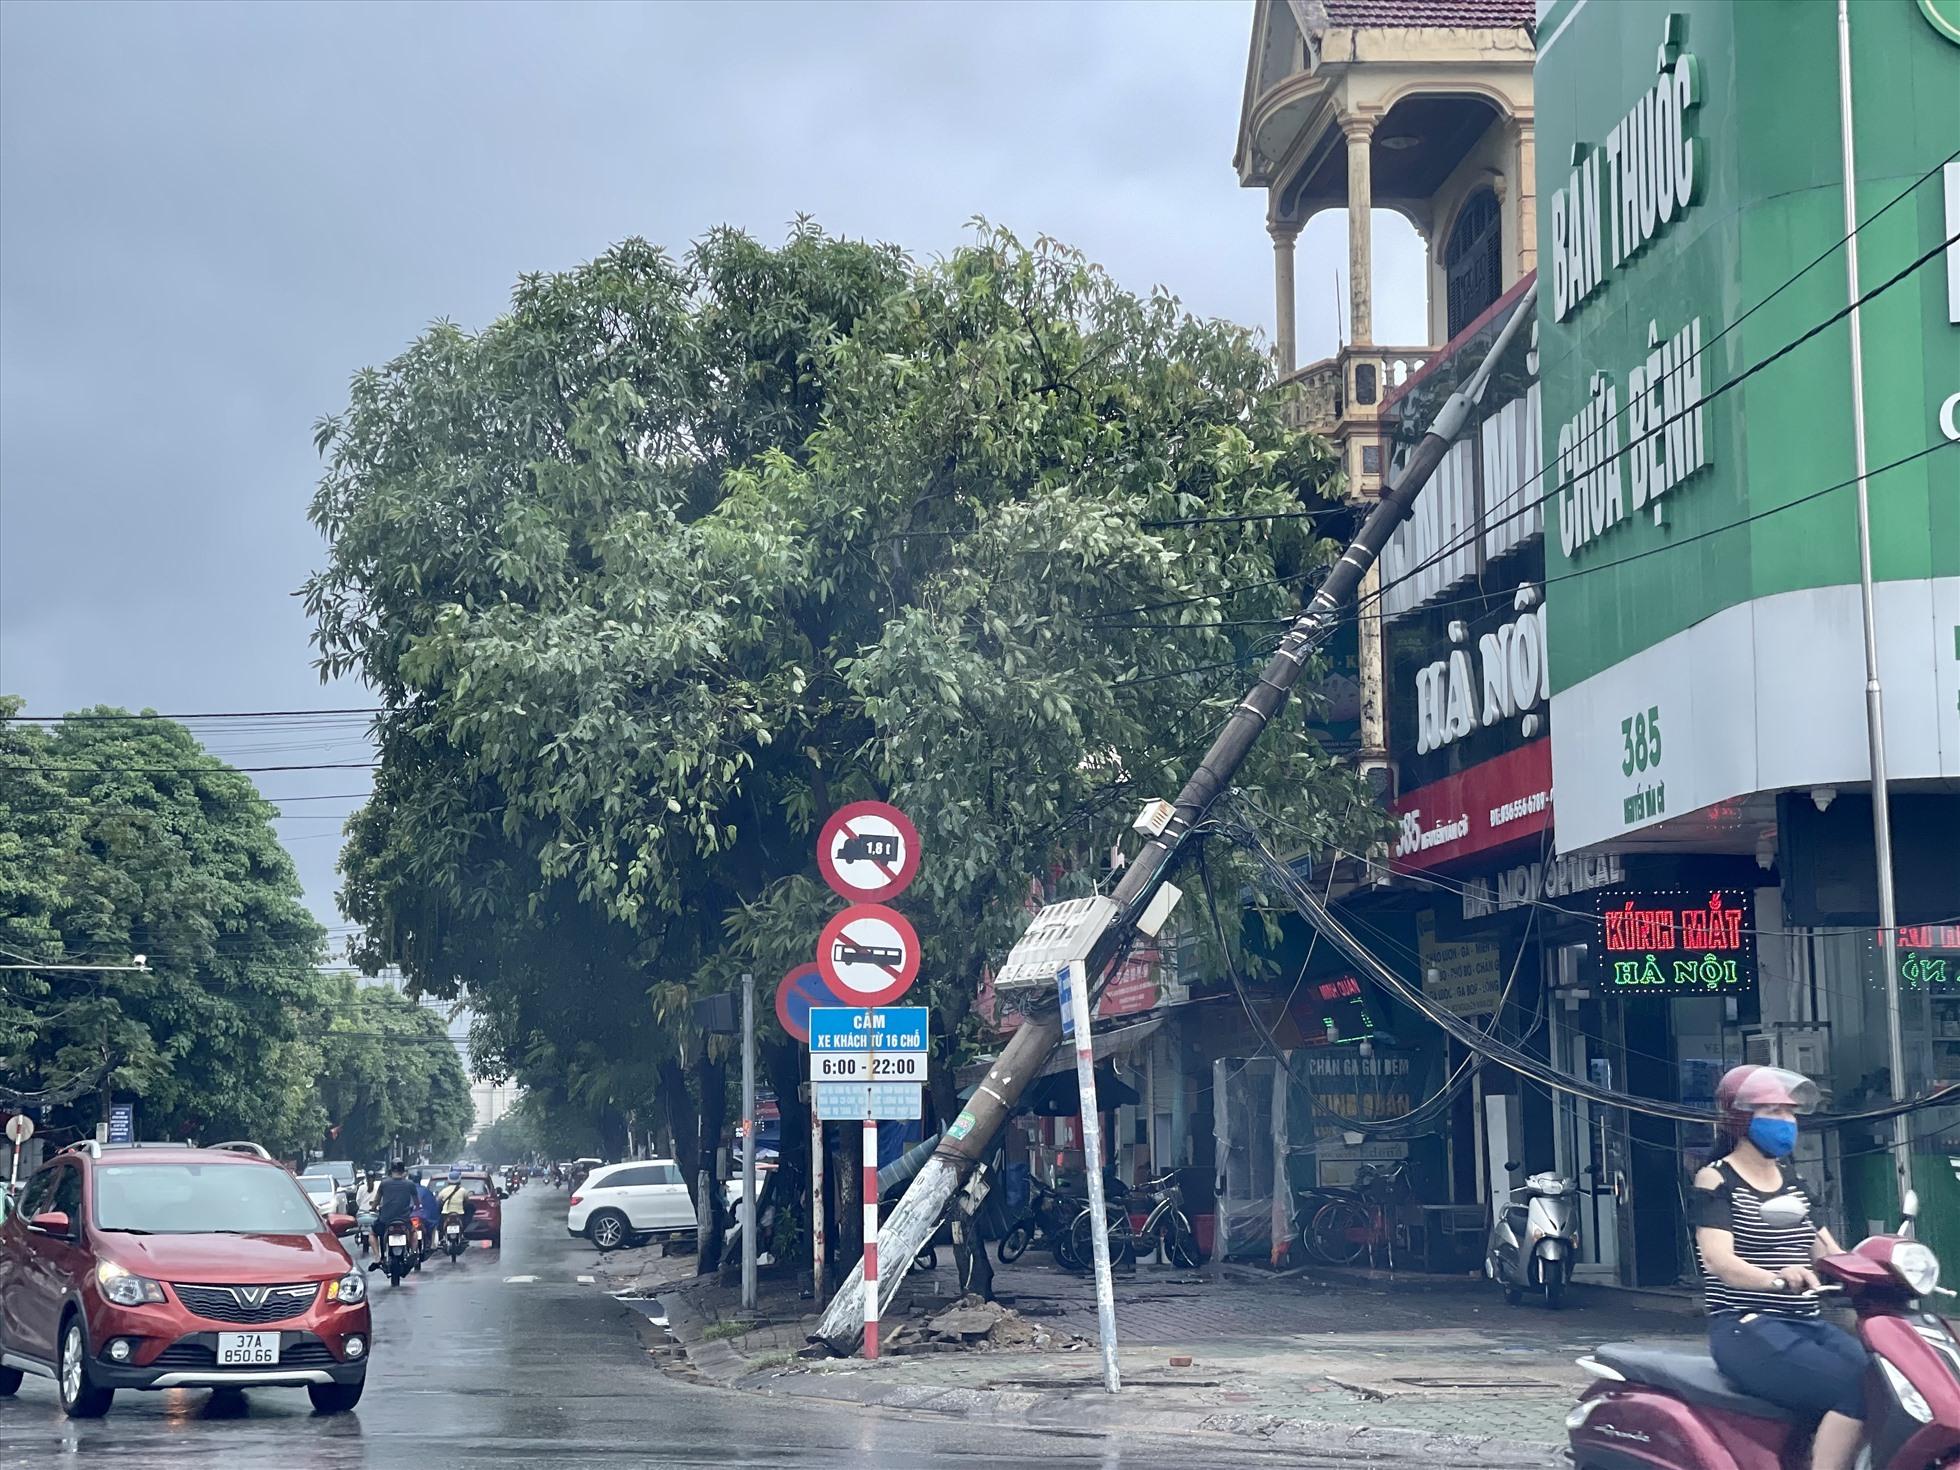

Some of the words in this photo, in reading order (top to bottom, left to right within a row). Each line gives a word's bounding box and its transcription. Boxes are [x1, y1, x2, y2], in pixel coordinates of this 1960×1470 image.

[1552, 142, 1604, 323] BÁN
[1606, 13, 1699, 269] THUỐC
[1558, 369, 1626, 558] CHỮA
[1629, 315, 1706, 527] BỆNH
[1415, 619, 1479, 756] HÀ
[1621, 705, 1662, 778] 385
[1605, 901, 1675, 950] KÍNH
[1681, 893, 1743, 950] MẮT
[1614, 954, 1665, 985] HÀ
[1673, 952, 1738, 989] NỘI
[817, 1034, 831, 1048] XE
[833, 1032, 867, 1048] KHÁCH
[870, 1032, 884, 1048] TỪ
[886, 1034, 898, 1048] 16
[900, 1029, 921, 1048] CHỖ
[822, 1059, 856, 1075] 6:00
[872, 1059, 915, 1075] 22:00
[224, 1349, 272, 1362] 850.66
[236, 1334, 262, 1348] 37A
